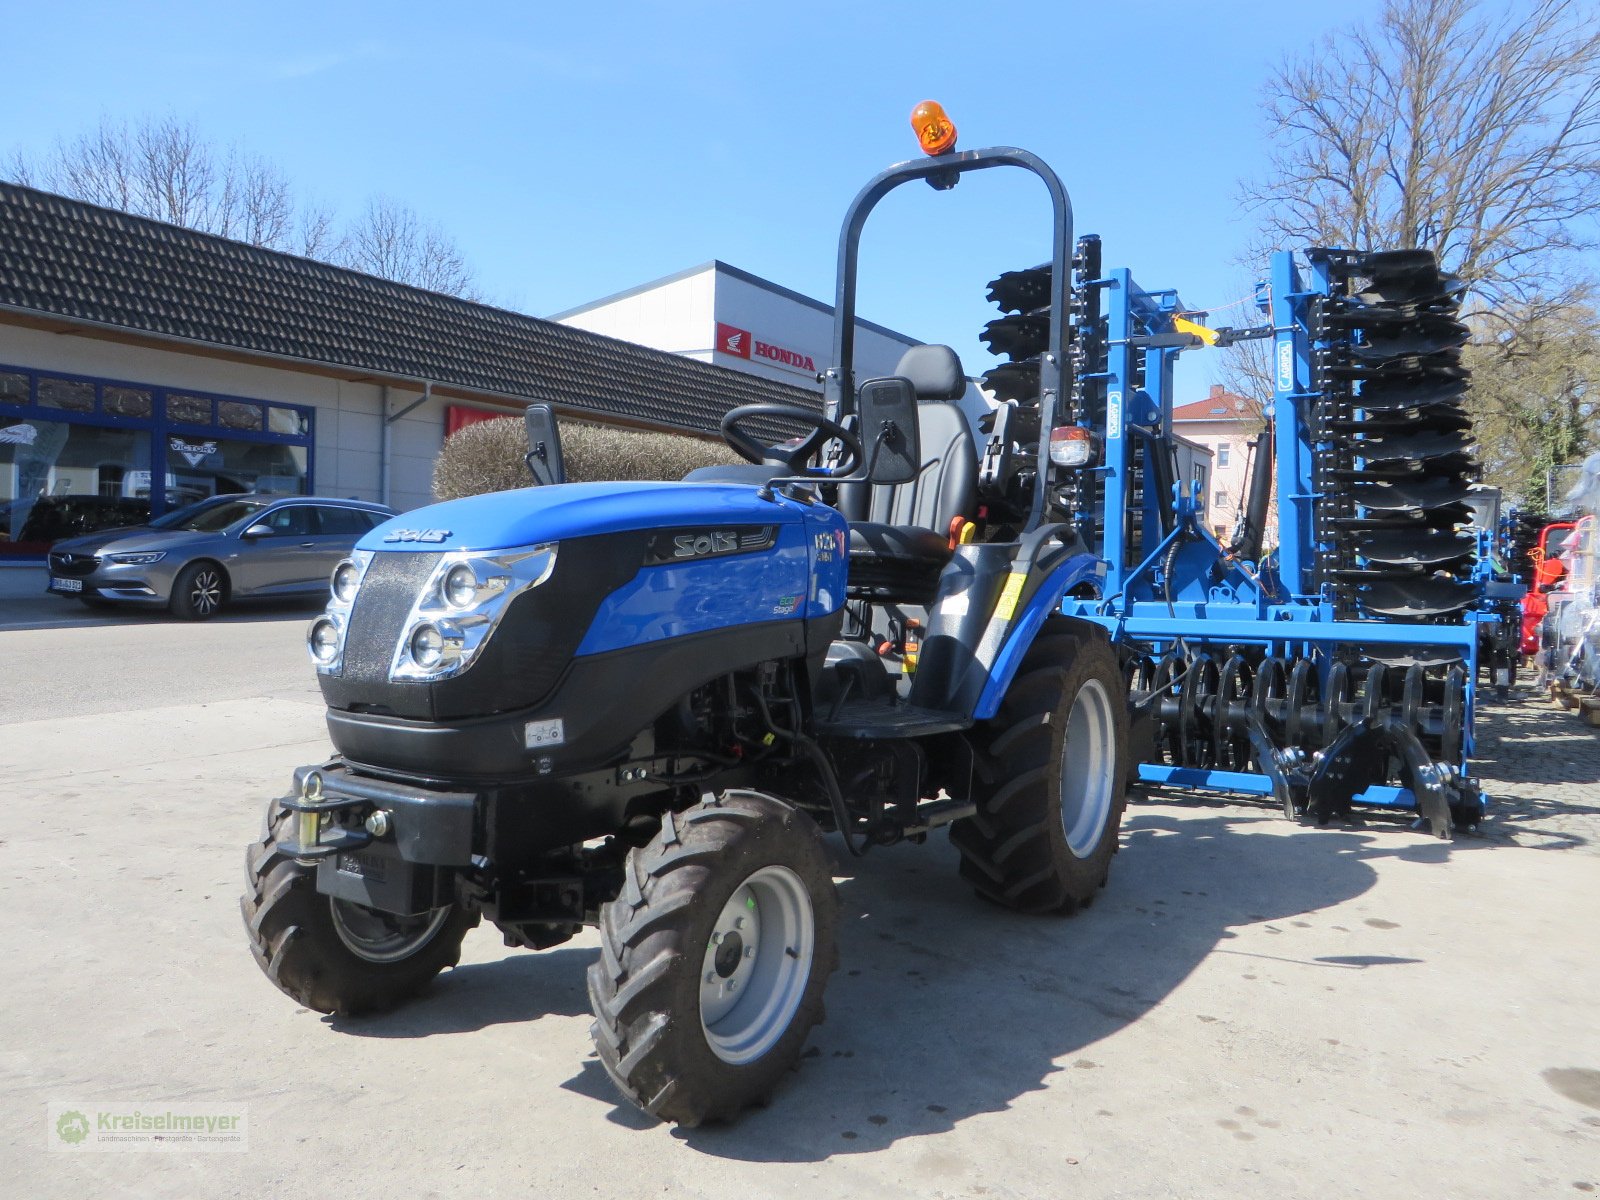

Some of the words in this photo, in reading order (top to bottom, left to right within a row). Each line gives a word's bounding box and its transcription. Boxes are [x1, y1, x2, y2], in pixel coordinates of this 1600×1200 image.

[727, 345, 741, 353] HONDA
[755, 341, 816, 372] HONDA
[1280, 344, 1290, 379] AGRIPOL
[171, 443, 217, 454] VICTORY
